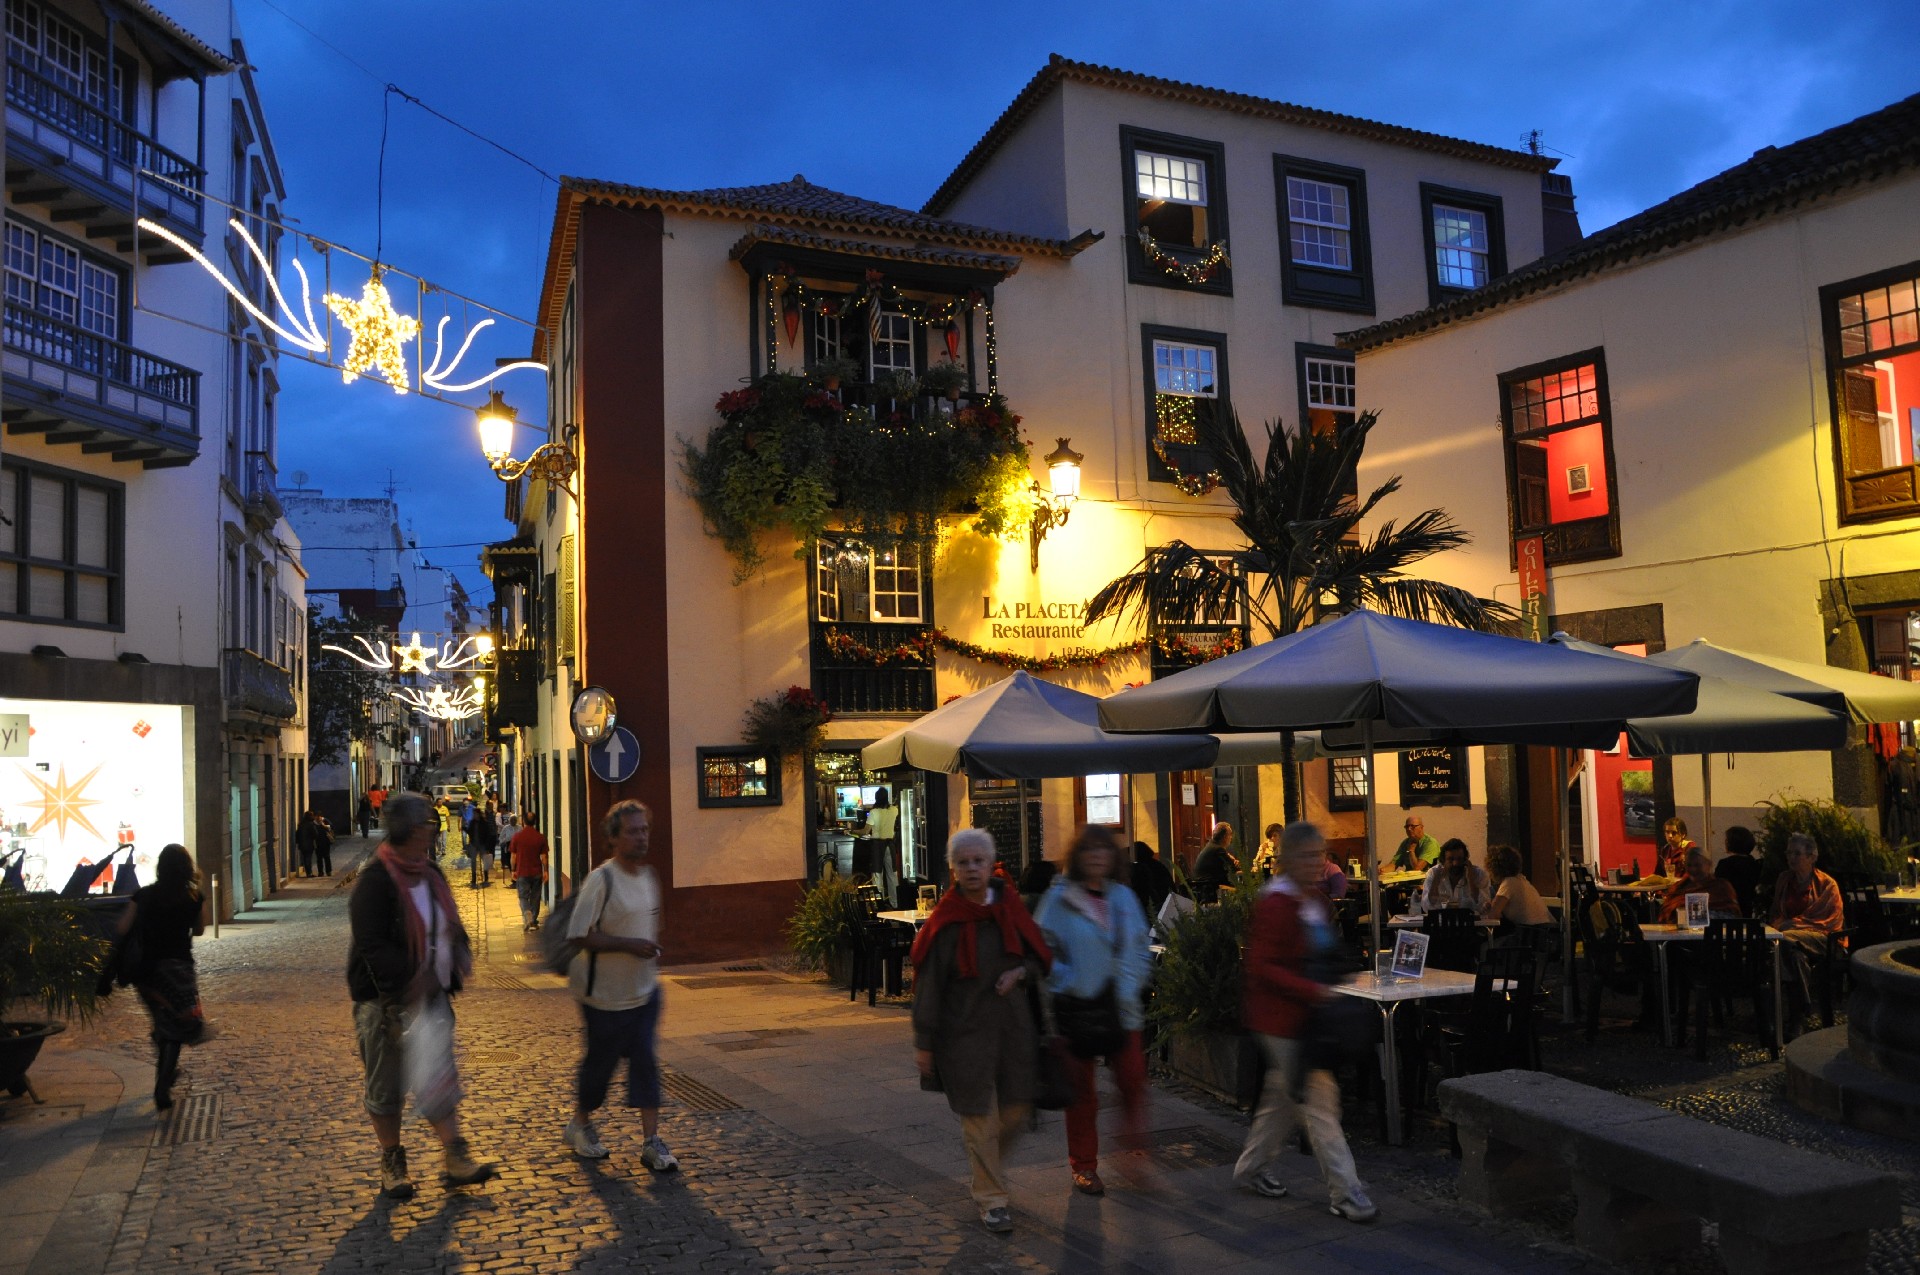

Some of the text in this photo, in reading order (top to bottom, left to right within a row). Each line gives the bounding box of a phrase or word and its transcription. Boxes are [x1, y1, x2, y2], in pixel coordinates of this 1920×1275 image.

[1523, 539, 1542, 643] GALERIA
[983, 596, 1090, 619] LA PLACETA
[992, 623, 1085, 639] Restaurante
[1075, 645, 1098, 658] Piso
[0, 722, 19, 751] yi
